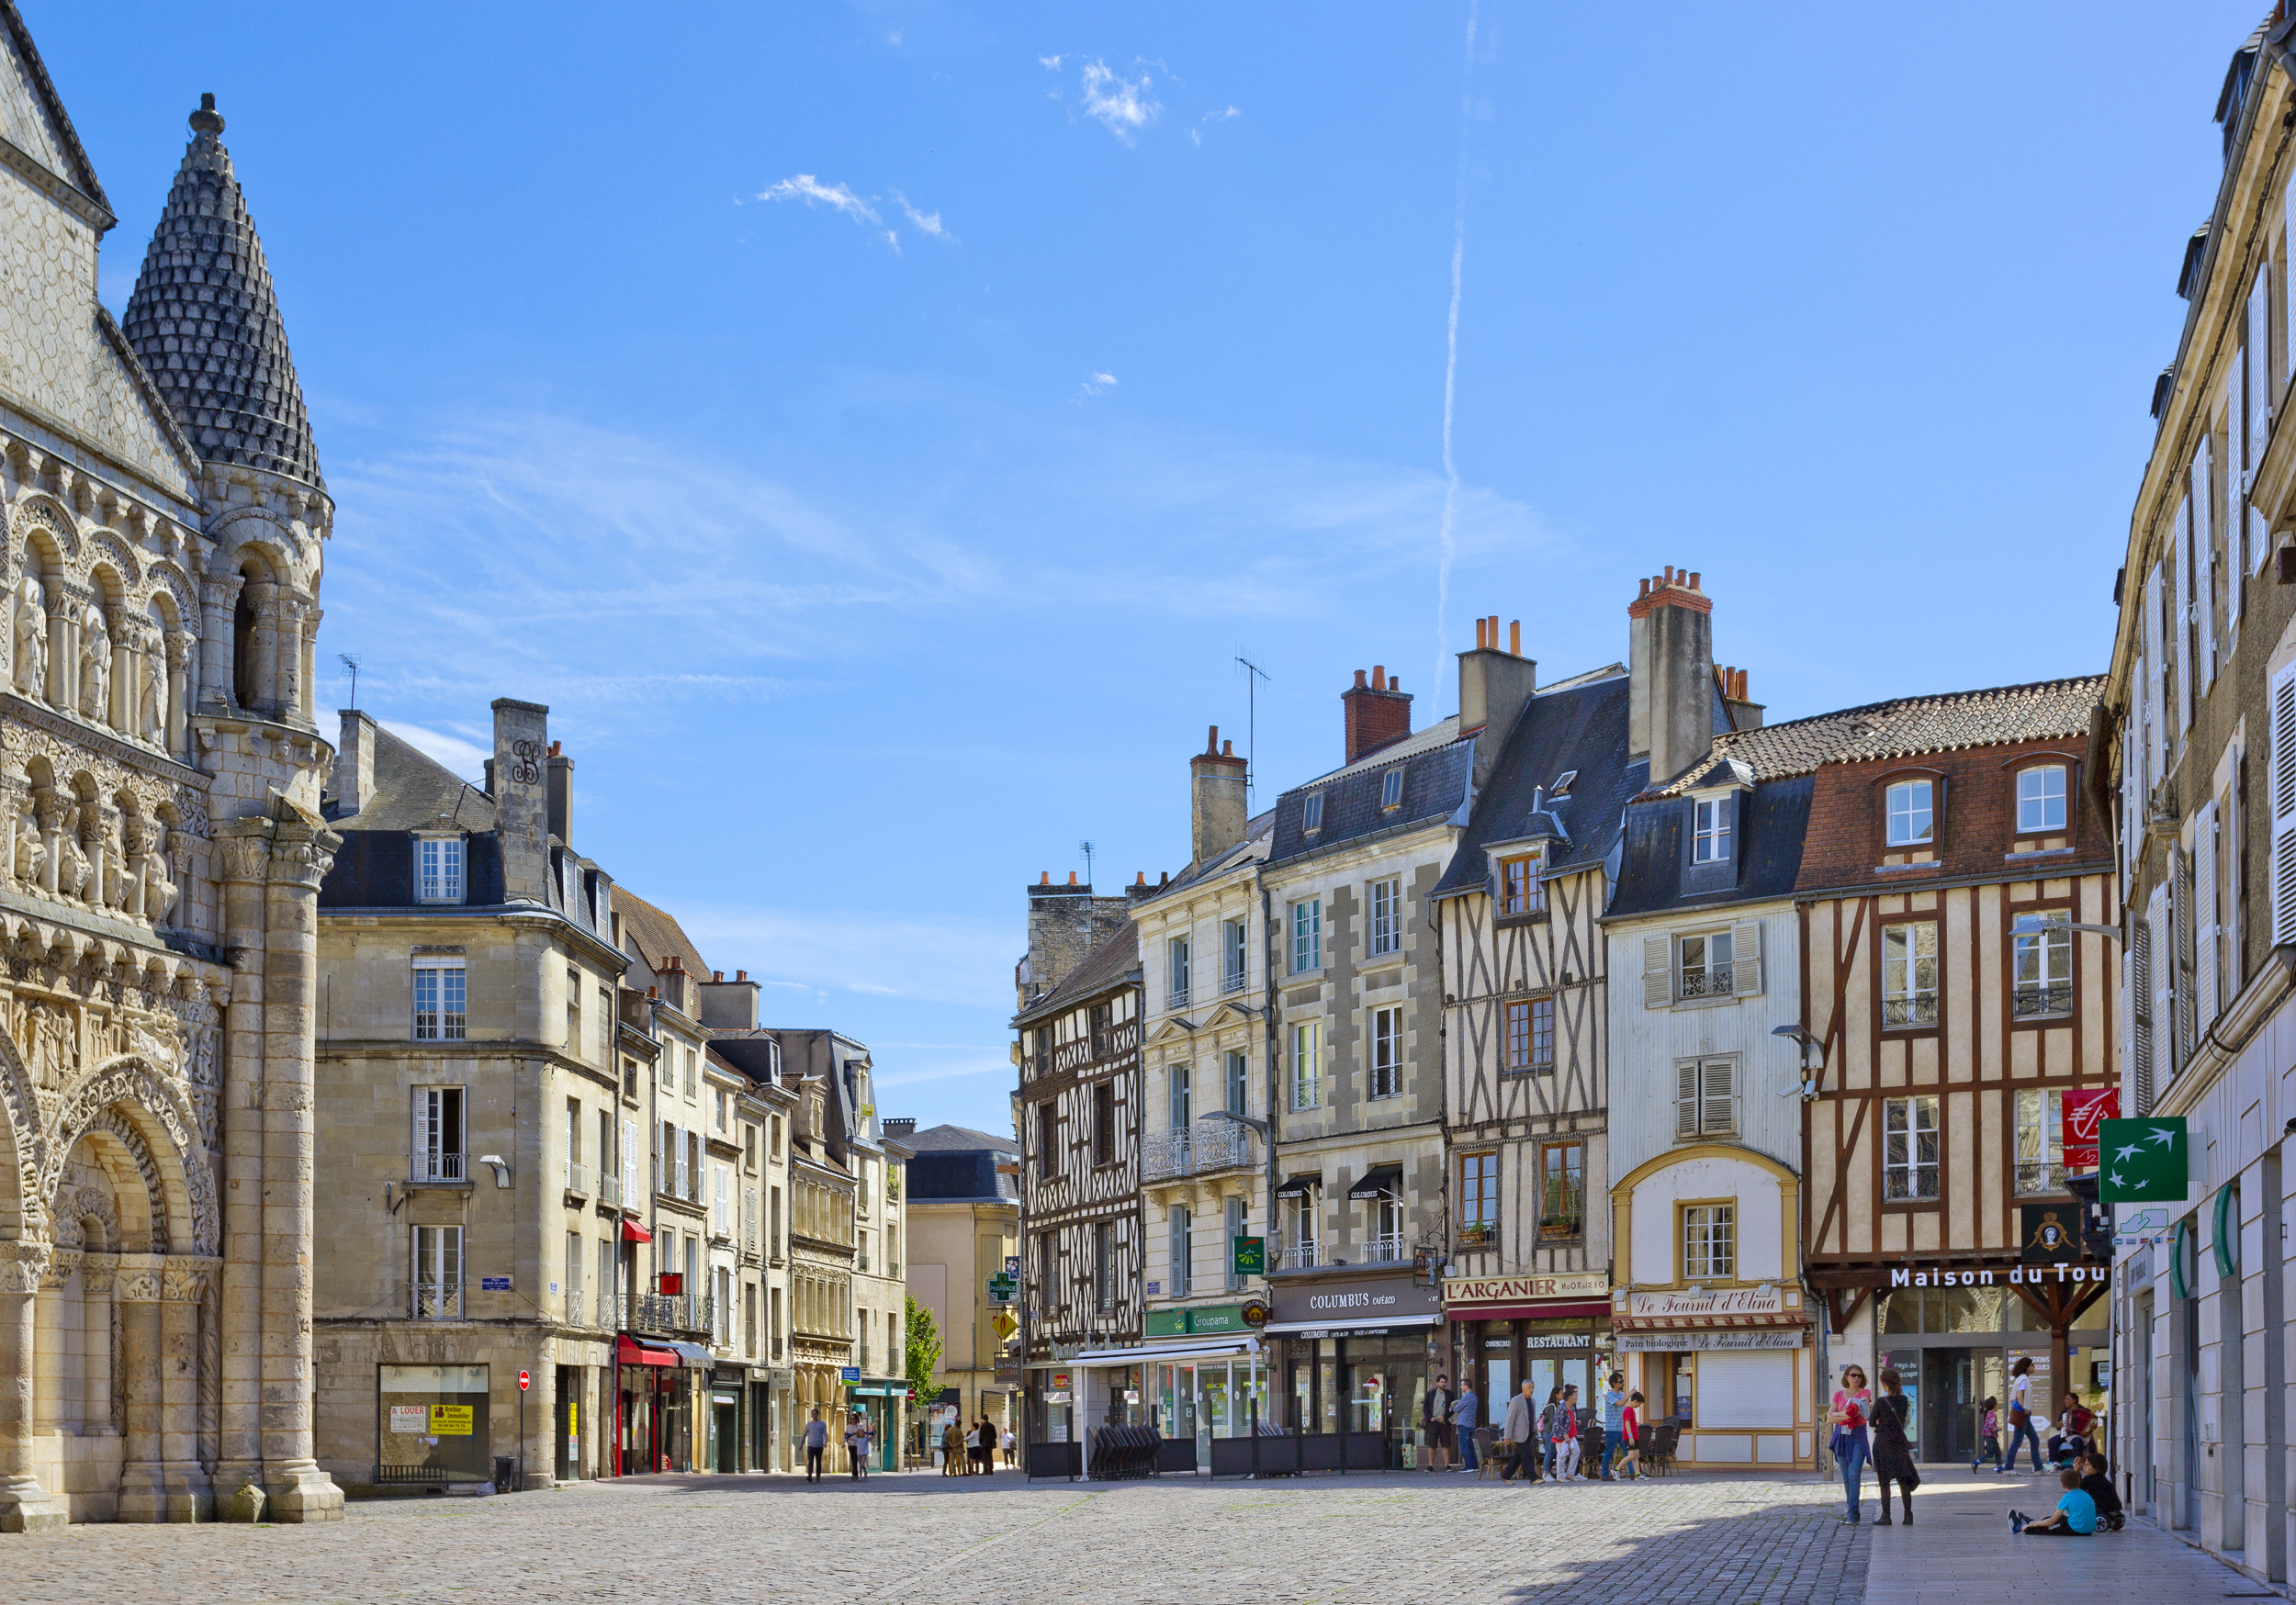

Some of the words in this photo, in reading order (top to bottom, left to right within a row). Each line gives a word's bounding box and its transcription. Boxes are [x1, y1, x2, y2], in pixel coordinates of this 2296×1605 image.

[1277, 1190, 1303, 1198] COLUMBUS
[1351, 1190, 1378, 1199] COLUMBUS
[1891, 1267, 1994, 1287] Maison
[2009, 1264, 2042, 1284] du
[2054, 1263, 2105, 1283] Tou
[1447, 1278, 1557, 1299] L'ARGANIER
[1310, 1292, 1369, 1309] COLUMBUS
[1637, 1295, 1655, 1313] Le
[1662, 1293, 1717, 1313] Fournil
[1721, 1292, 1776, 1311] d'Elina
[1194, 1315, 1229, 1328] Groupama
[1300, 1330, 1329, 1339] COLUMBUS
[1526, 1335, 1590, 1349] RESTAURANT
[1595, 1337, 1606, 1345] BA
[1625, 1340, 1644, 1348] Pain
[1646, 1339, 1689, 1349] biologique
[1698, 1337, 1711, 1348] Le
[1713, 1336, 1755, 1348] Fournil
[1755, 1335, 1794, 1347] d'Elina
[400, 1406, 424, 1415] LOUER
